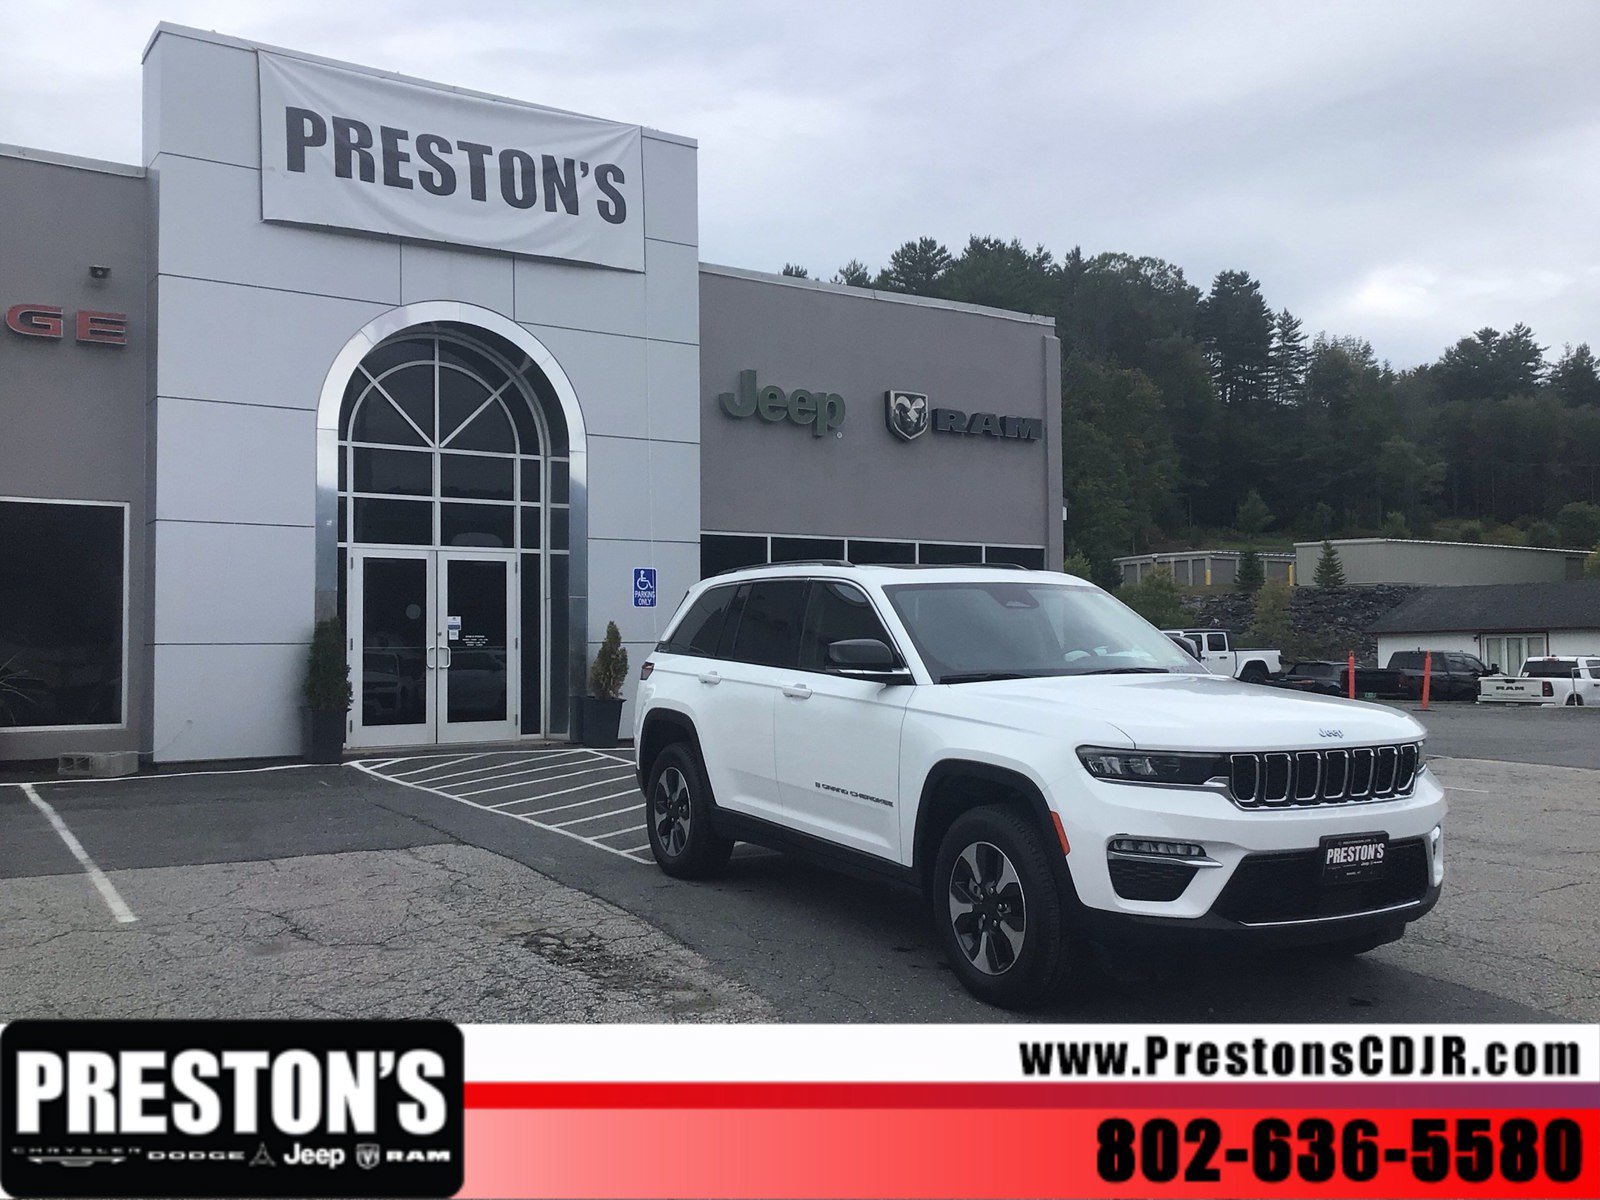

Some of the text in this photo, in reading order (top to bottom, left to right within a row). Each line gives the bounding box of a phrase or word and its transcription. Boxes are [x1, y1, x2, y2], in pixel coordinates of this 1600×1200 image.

[285, 106, 627, 225] PRESTON'S
[719, 369, 846, 437] Jeep
[931, 407, 1043, 440] RAM
[1318, 728, 1344, 739] Jeep
[1326, 843, 1385, 865] PRESTON'S
